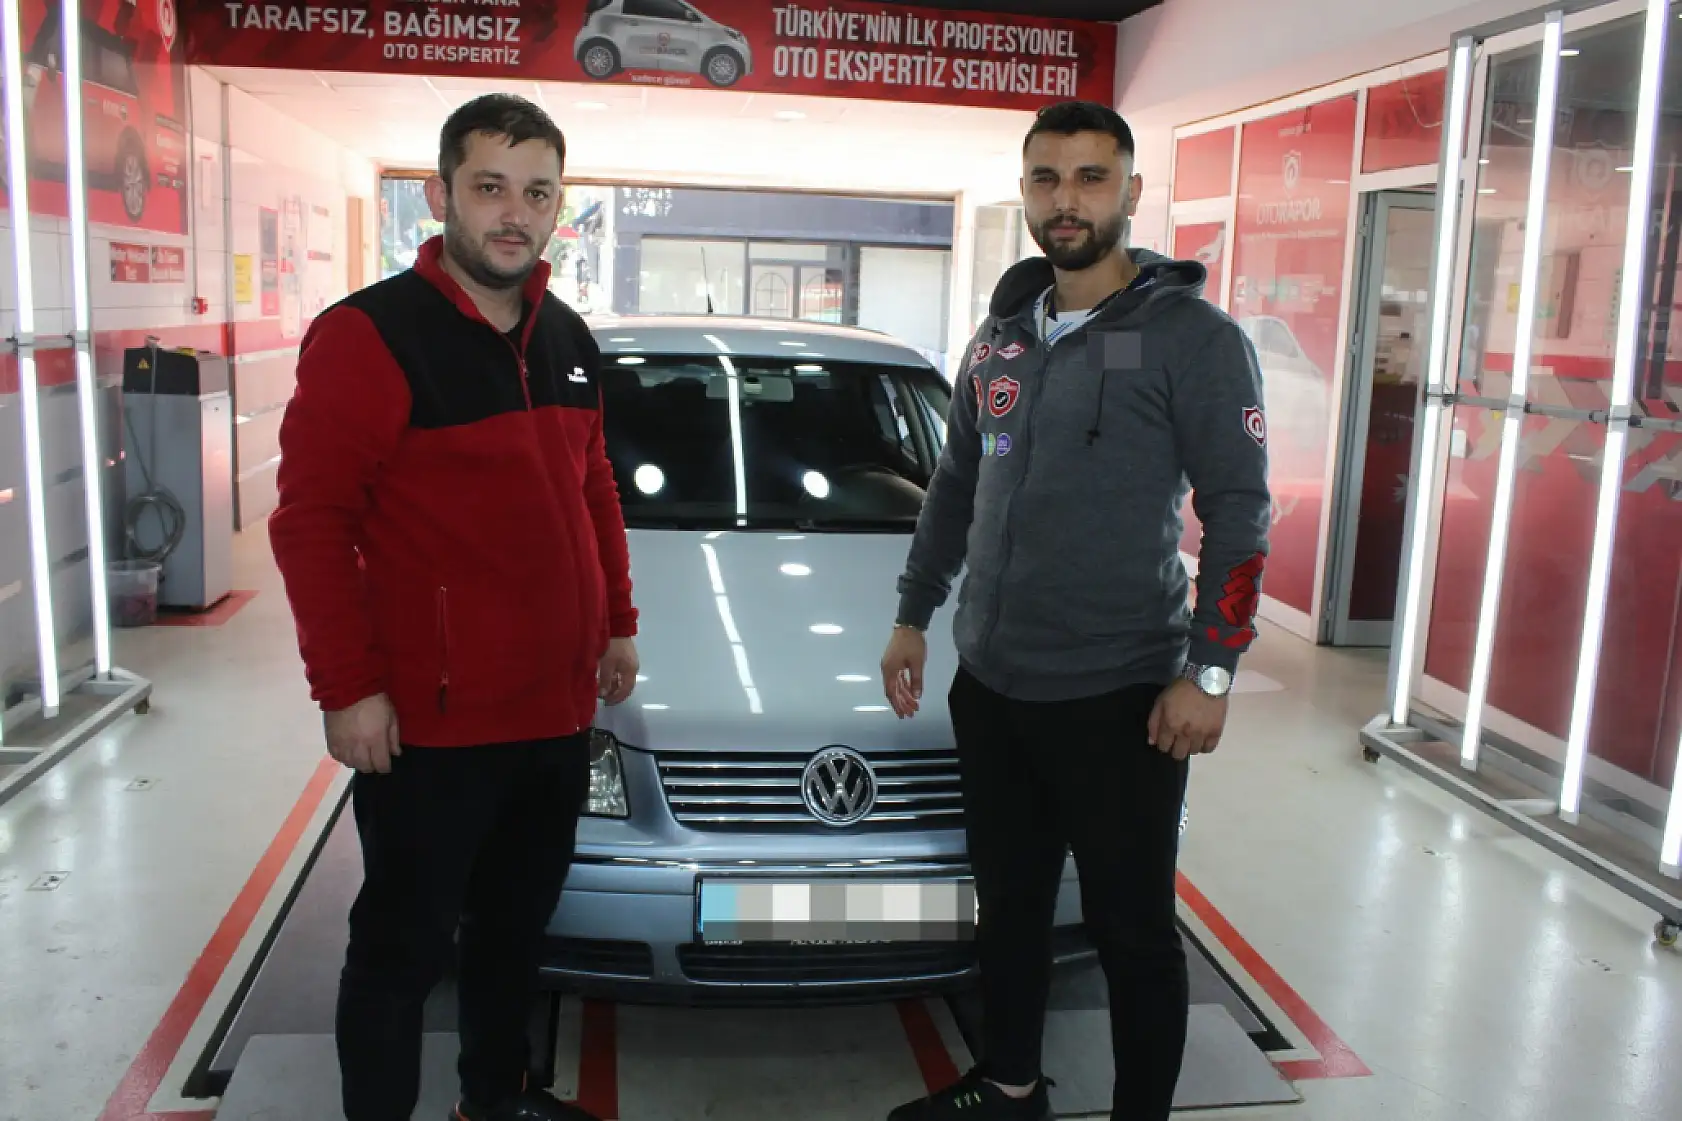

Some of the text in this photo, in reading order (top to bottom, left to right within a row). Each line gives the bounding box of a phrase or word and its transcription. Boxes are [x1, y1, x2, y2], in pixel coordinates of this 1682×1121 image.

[225, 3, 520, 42] TARAFSIZ, BAĞIMSIZ
[906, 13, 937, 48] İLK
[942, 20, 1078, 58] PROFESYONEL
[384, 43, 520, 65] OTO EKSPERTİZ
[773, 46, 1077, 97] OTO EKSPERTİZ SERVİSLERİ
